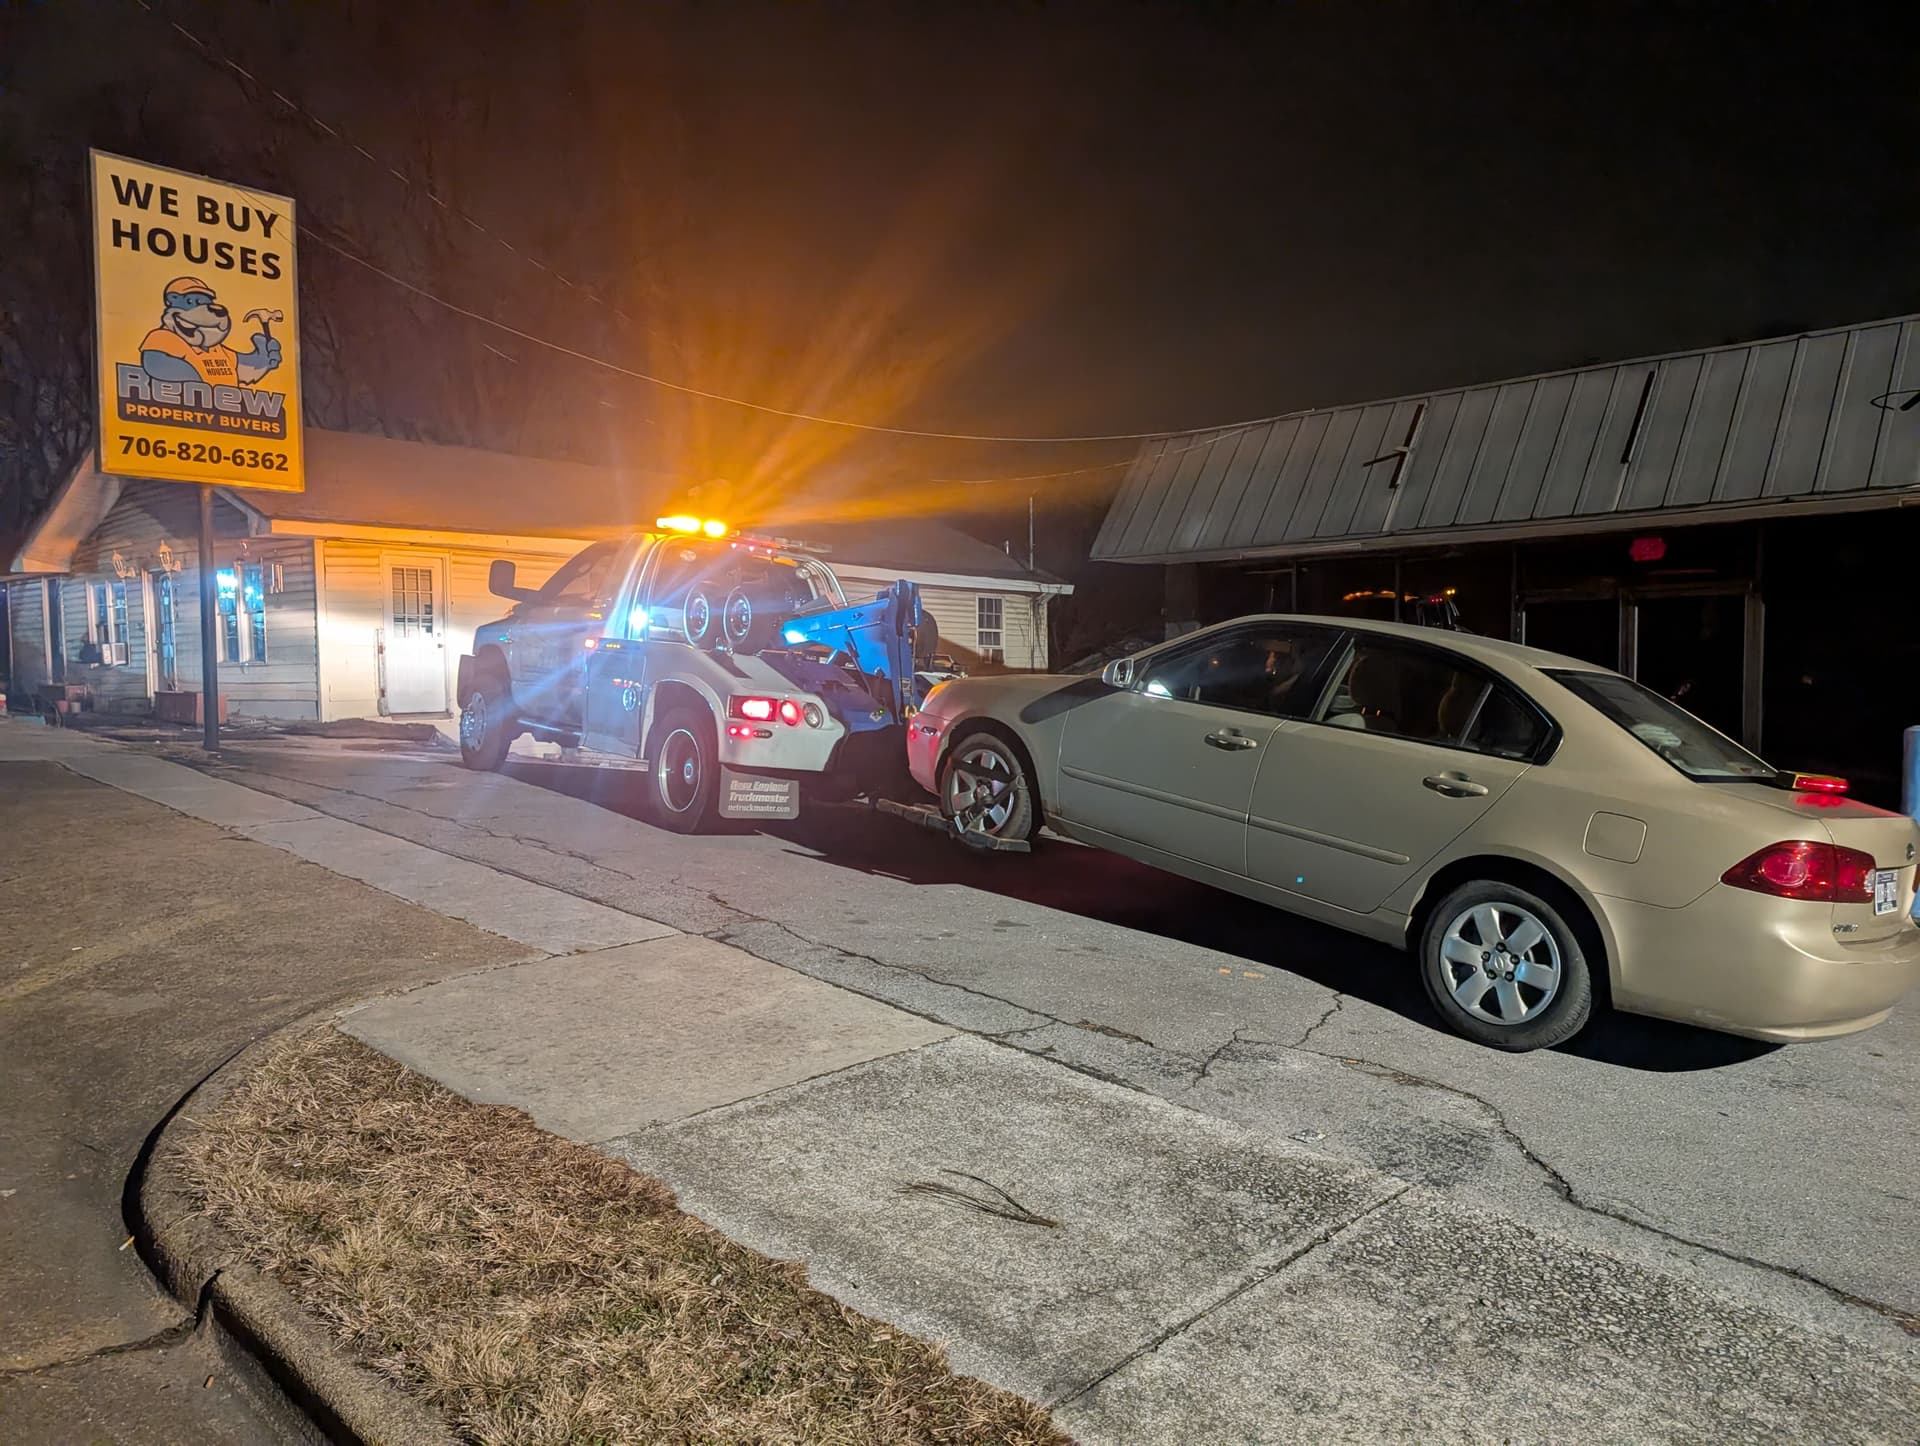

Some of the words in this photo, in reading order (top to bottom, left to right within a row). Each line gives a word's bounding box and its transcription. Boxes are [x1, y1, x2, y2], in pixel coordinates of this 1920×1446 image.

[110, 174, 179, 217] WE
[197, 195, 279, 238] BUY
[112, 218, 281, 280] HOUSES
[203, 358, 214, 368] WE
[215, 359, 228, 369] BUY
[206, 367, 233, 377] HOUSES
[118, 365, 285, 418] Renew
[126, 404, 214, 425] PROPERTY
[219, 415, 281, 434] BUYERS
[118, 435, 289, 472] 706-820-6362
[729, 792, 790, 803] Truckmaster
